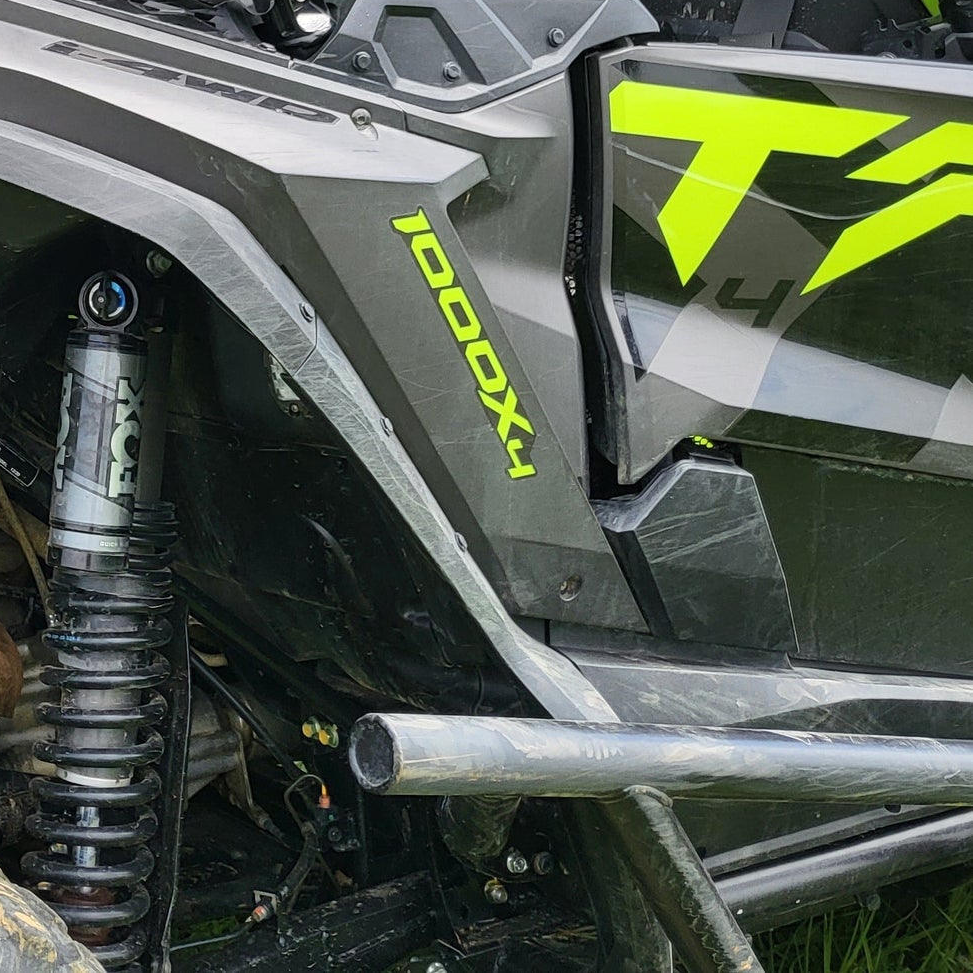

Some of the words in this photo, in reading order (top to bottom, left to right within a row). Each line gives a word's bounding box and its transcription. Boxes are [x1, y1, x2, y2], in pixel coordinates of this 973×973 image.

[41, 40, 339, 125] i-4WD
[391, 207, 537, 479] 1000X4
[714, 277, 797, 328] 4
